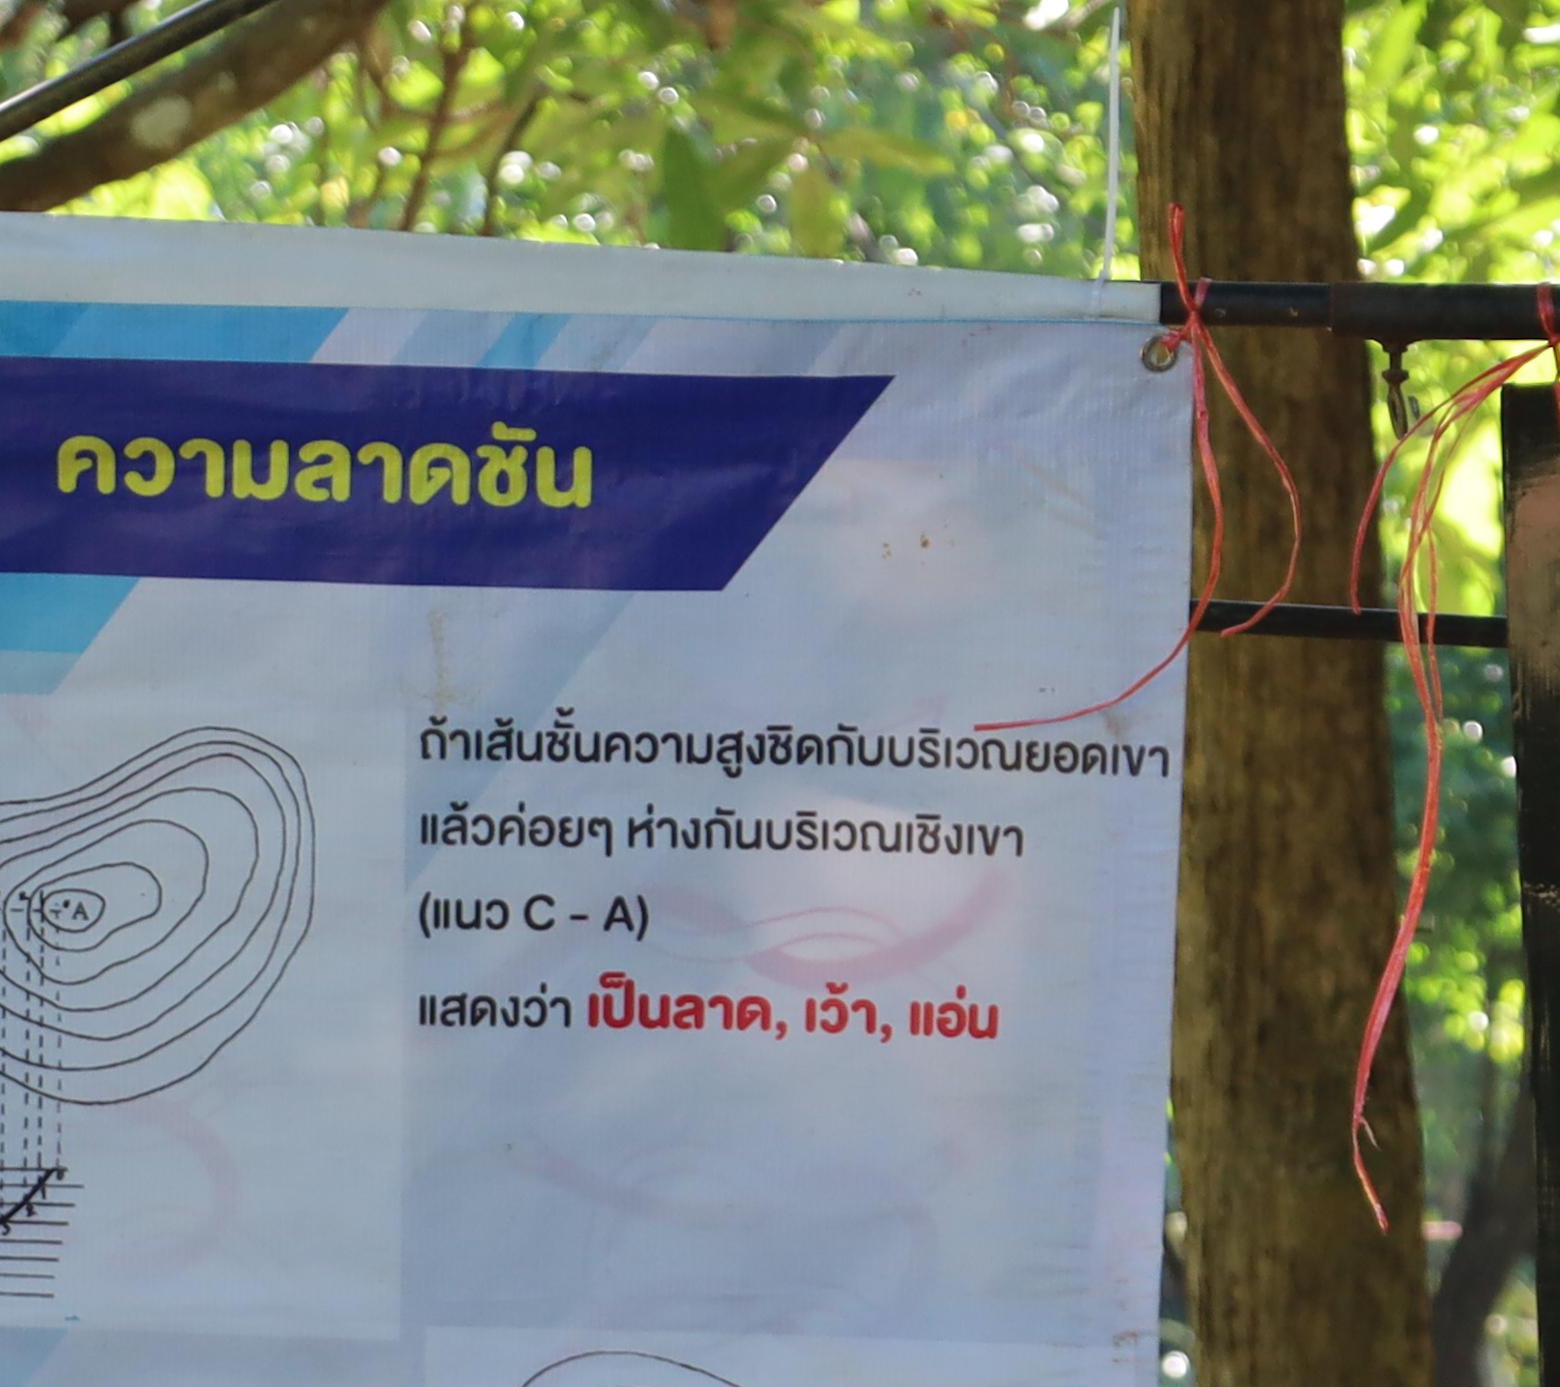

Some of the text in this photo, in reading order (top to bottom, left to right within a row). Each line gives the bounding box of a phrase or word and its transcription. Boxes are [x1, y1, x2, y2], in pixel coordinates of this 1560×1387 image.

[57, 422, 593, 508] ความลาดชัน
[419, 706, 1170, 779] ถ้าเส้นชั้นความสูงชิดกับบริเวณยอดเขา
[420, 800, 1024, 858] แล้วค่อยๆ ห่างกันบริเวณเชิงเขา
[71, 901, 89, 921] A
[419, 891, 510, 940] (แนว
[523, 894, 555, 933] C
[603, 894, 649, 942] A)
[419, 971, 1000, 1044] แสดงว่า เป็นลาด, เว้า, แอ่น
